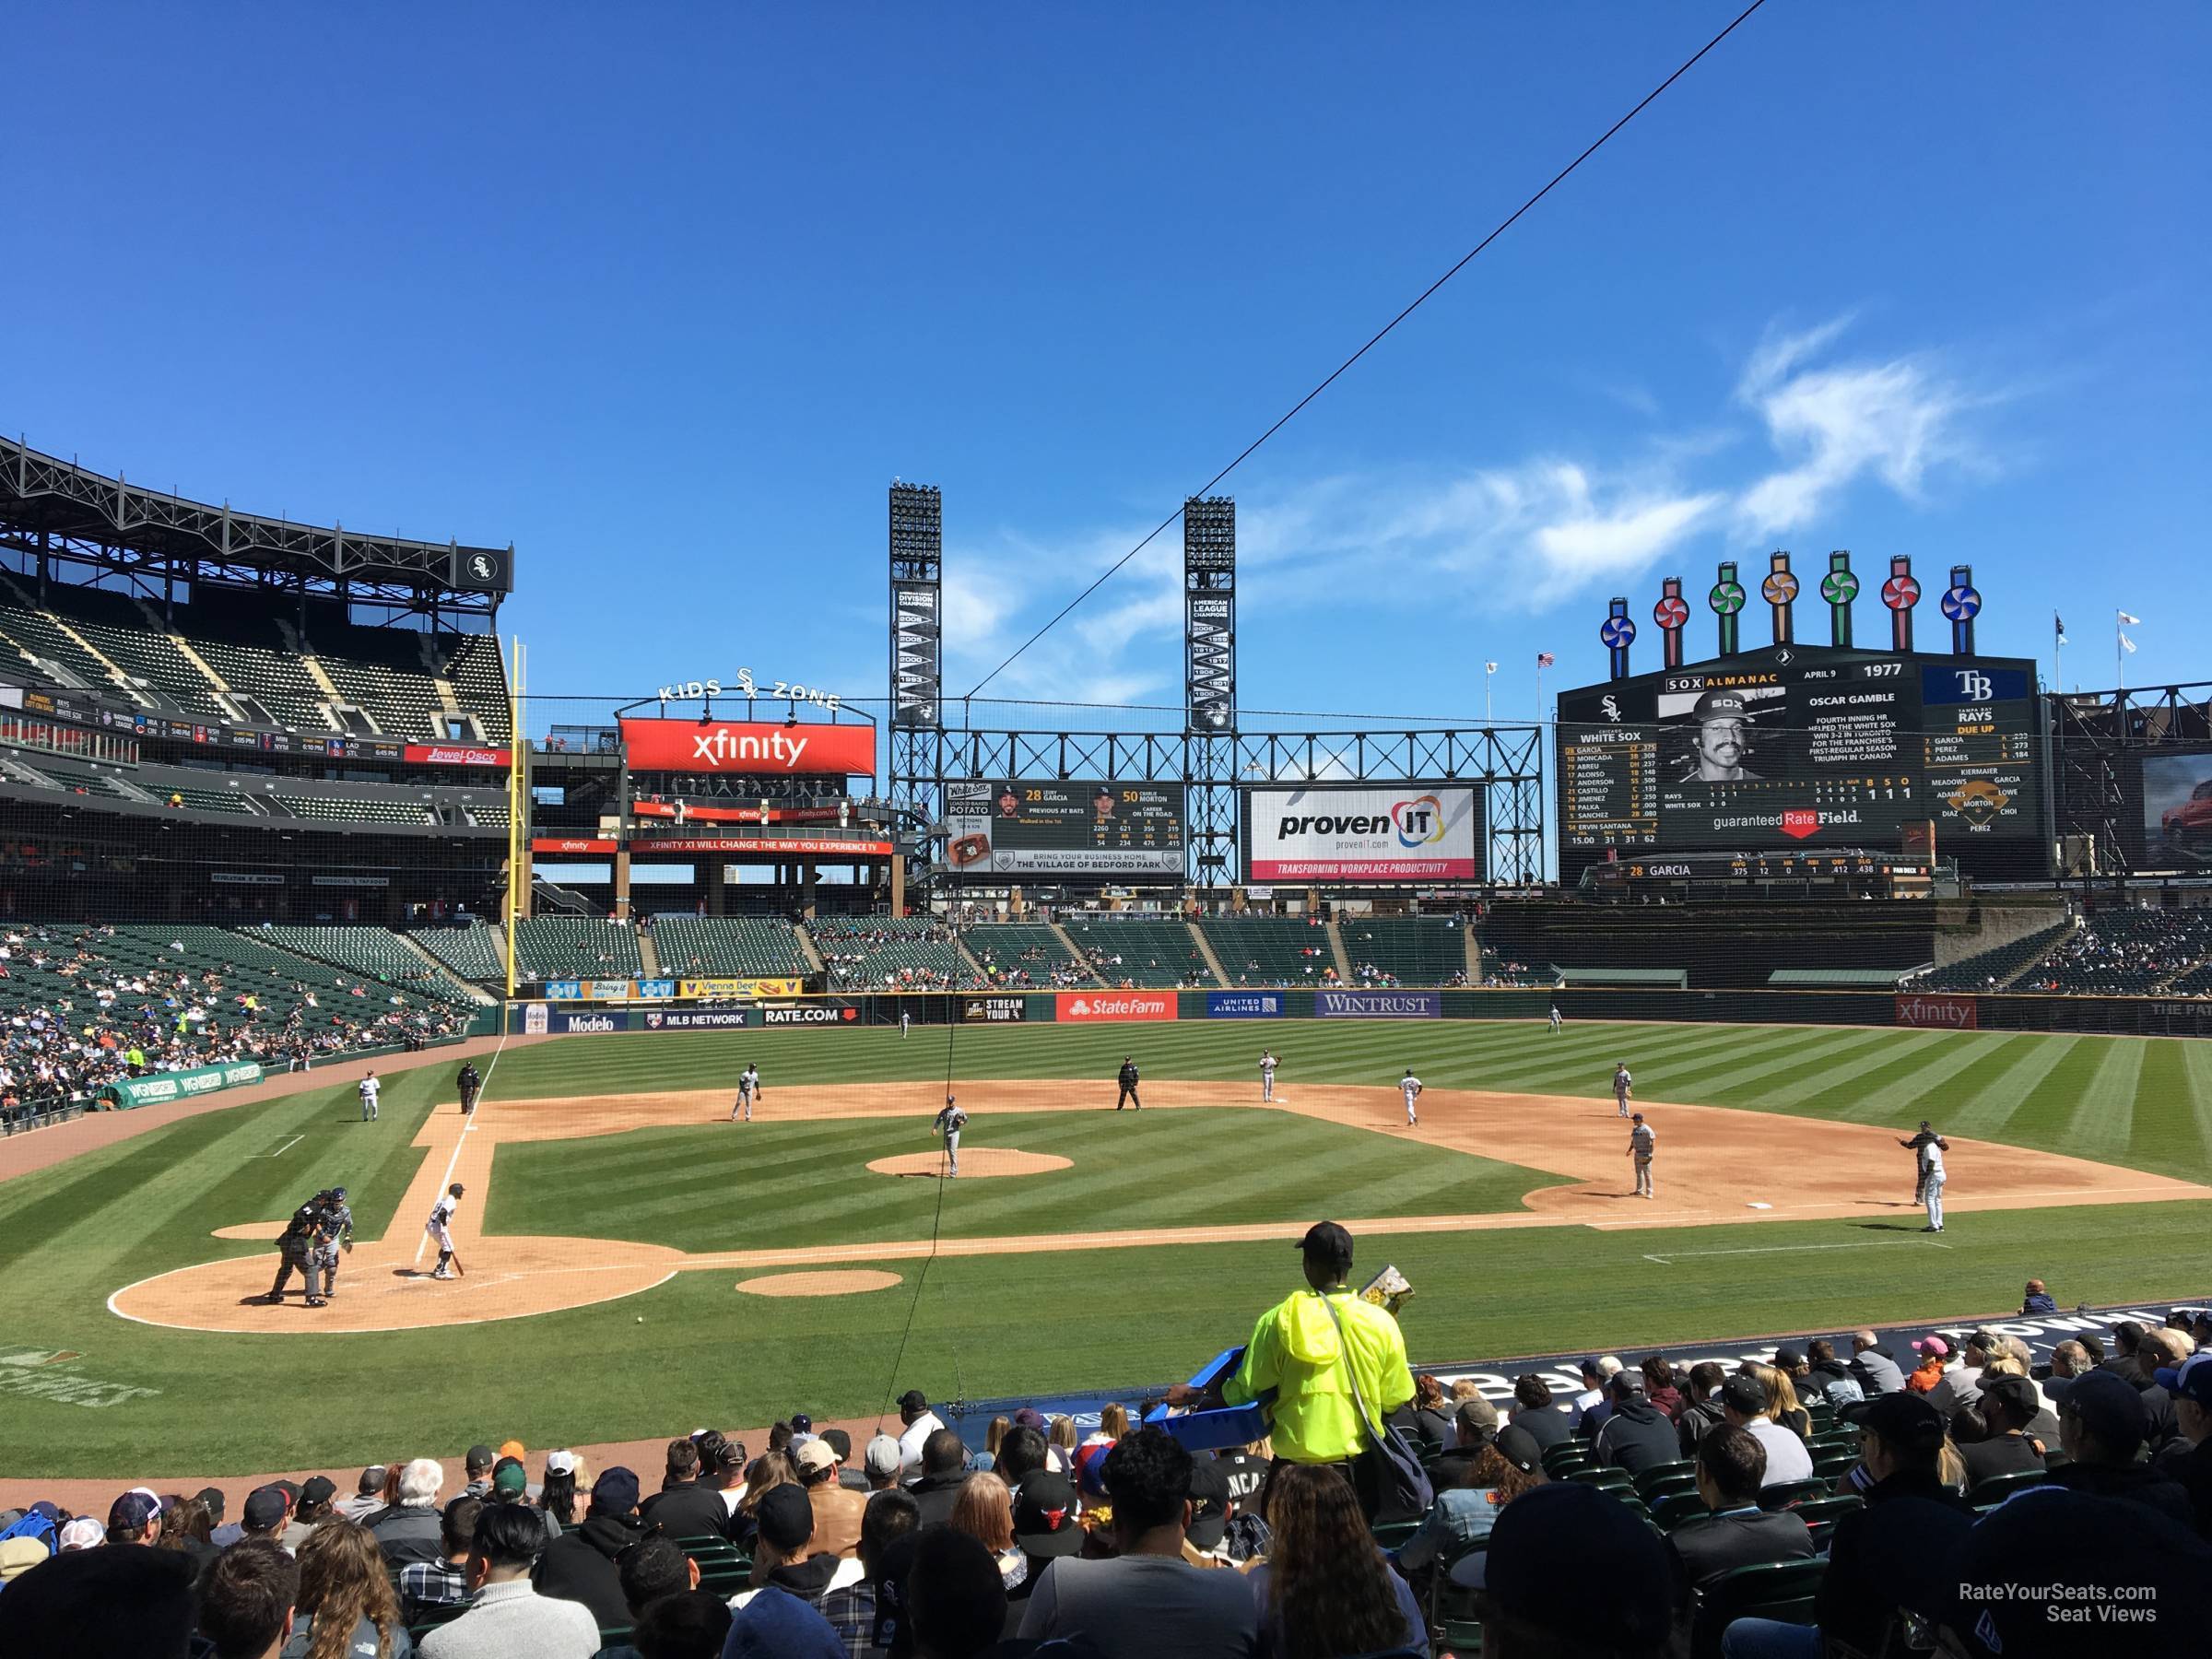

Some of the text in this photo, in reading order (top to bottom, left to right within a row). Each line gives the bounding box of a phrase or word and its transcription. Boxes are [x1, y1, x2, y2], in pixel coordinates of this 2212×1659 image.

[1864, 664, 1901, 677] 1977
[1669, 674, 1777, 689] SOX ALMANAC
[658, 679, 722, 704] KIDS
[772, 681, 841, 712] ZONE
[1809, 693, 1895, 706] OSCAR GAMBLE
[1712, 700, 1742, 710] SOX
[57, 709, 71, 718] WHITE
[113, 713, 135, 723] NATIONAL
[1959, 712, 1992, 722] RAYS
[115, 721, 132, 729] LEAGUE
[207, 727, 220, 735] WSH
[1581, 733, 1641, 743] WHITE SOX
[693, 729, 807, 766] xfinity
[1809, 746, 1864, 755] FIRST-REGULAR
[428, 748, 497, 762] Jewel-Osco
[949, 783, 989, 795] White Sox
[1026, 790, 1041, 801] 28
[1123, 792, 1138, 802] 50
[1277, 812, 1430, 840] proven IT
[1713, 814, 1782, 830] guaranteed
[1785, 813, 1814, 825] Rate
[561, 841, 589, 851] xfinity
[651, 841, 877, 851] XFINITY X1 WILL CHANGE THE WAY YOU EXPERIENCE TV
[1336, 840, 1388, 850] provenIT.com
[1277, 863, 1448, 874] TRANSFORMING WORKPLACE PRODUCTIVITY
[1630, 866, 1643, 876] 28
[1650, 865, 1690, 876] GARCIA
[594, 982, 618, 991] Bring
[737, 982, 757, 990] Beef
[986, 999, 1022, 1008] STREAM
[986, 1009, 1009, 1019] YOUR
[1900, 999, 1971, 1027] xfinity
[2151, 1005, 2182, 1015] THE
[667, 1015, 744, 1025] MLB NETWORK
[765, 1009, 838, 1022] RATE.COM
[569, 1017, 613, 1032] Modelo
[225, 1071, 242, 1084] WGN
[181, 1077, 202, 1091] WGN
[127, 1084, 152, 1098] WGN
